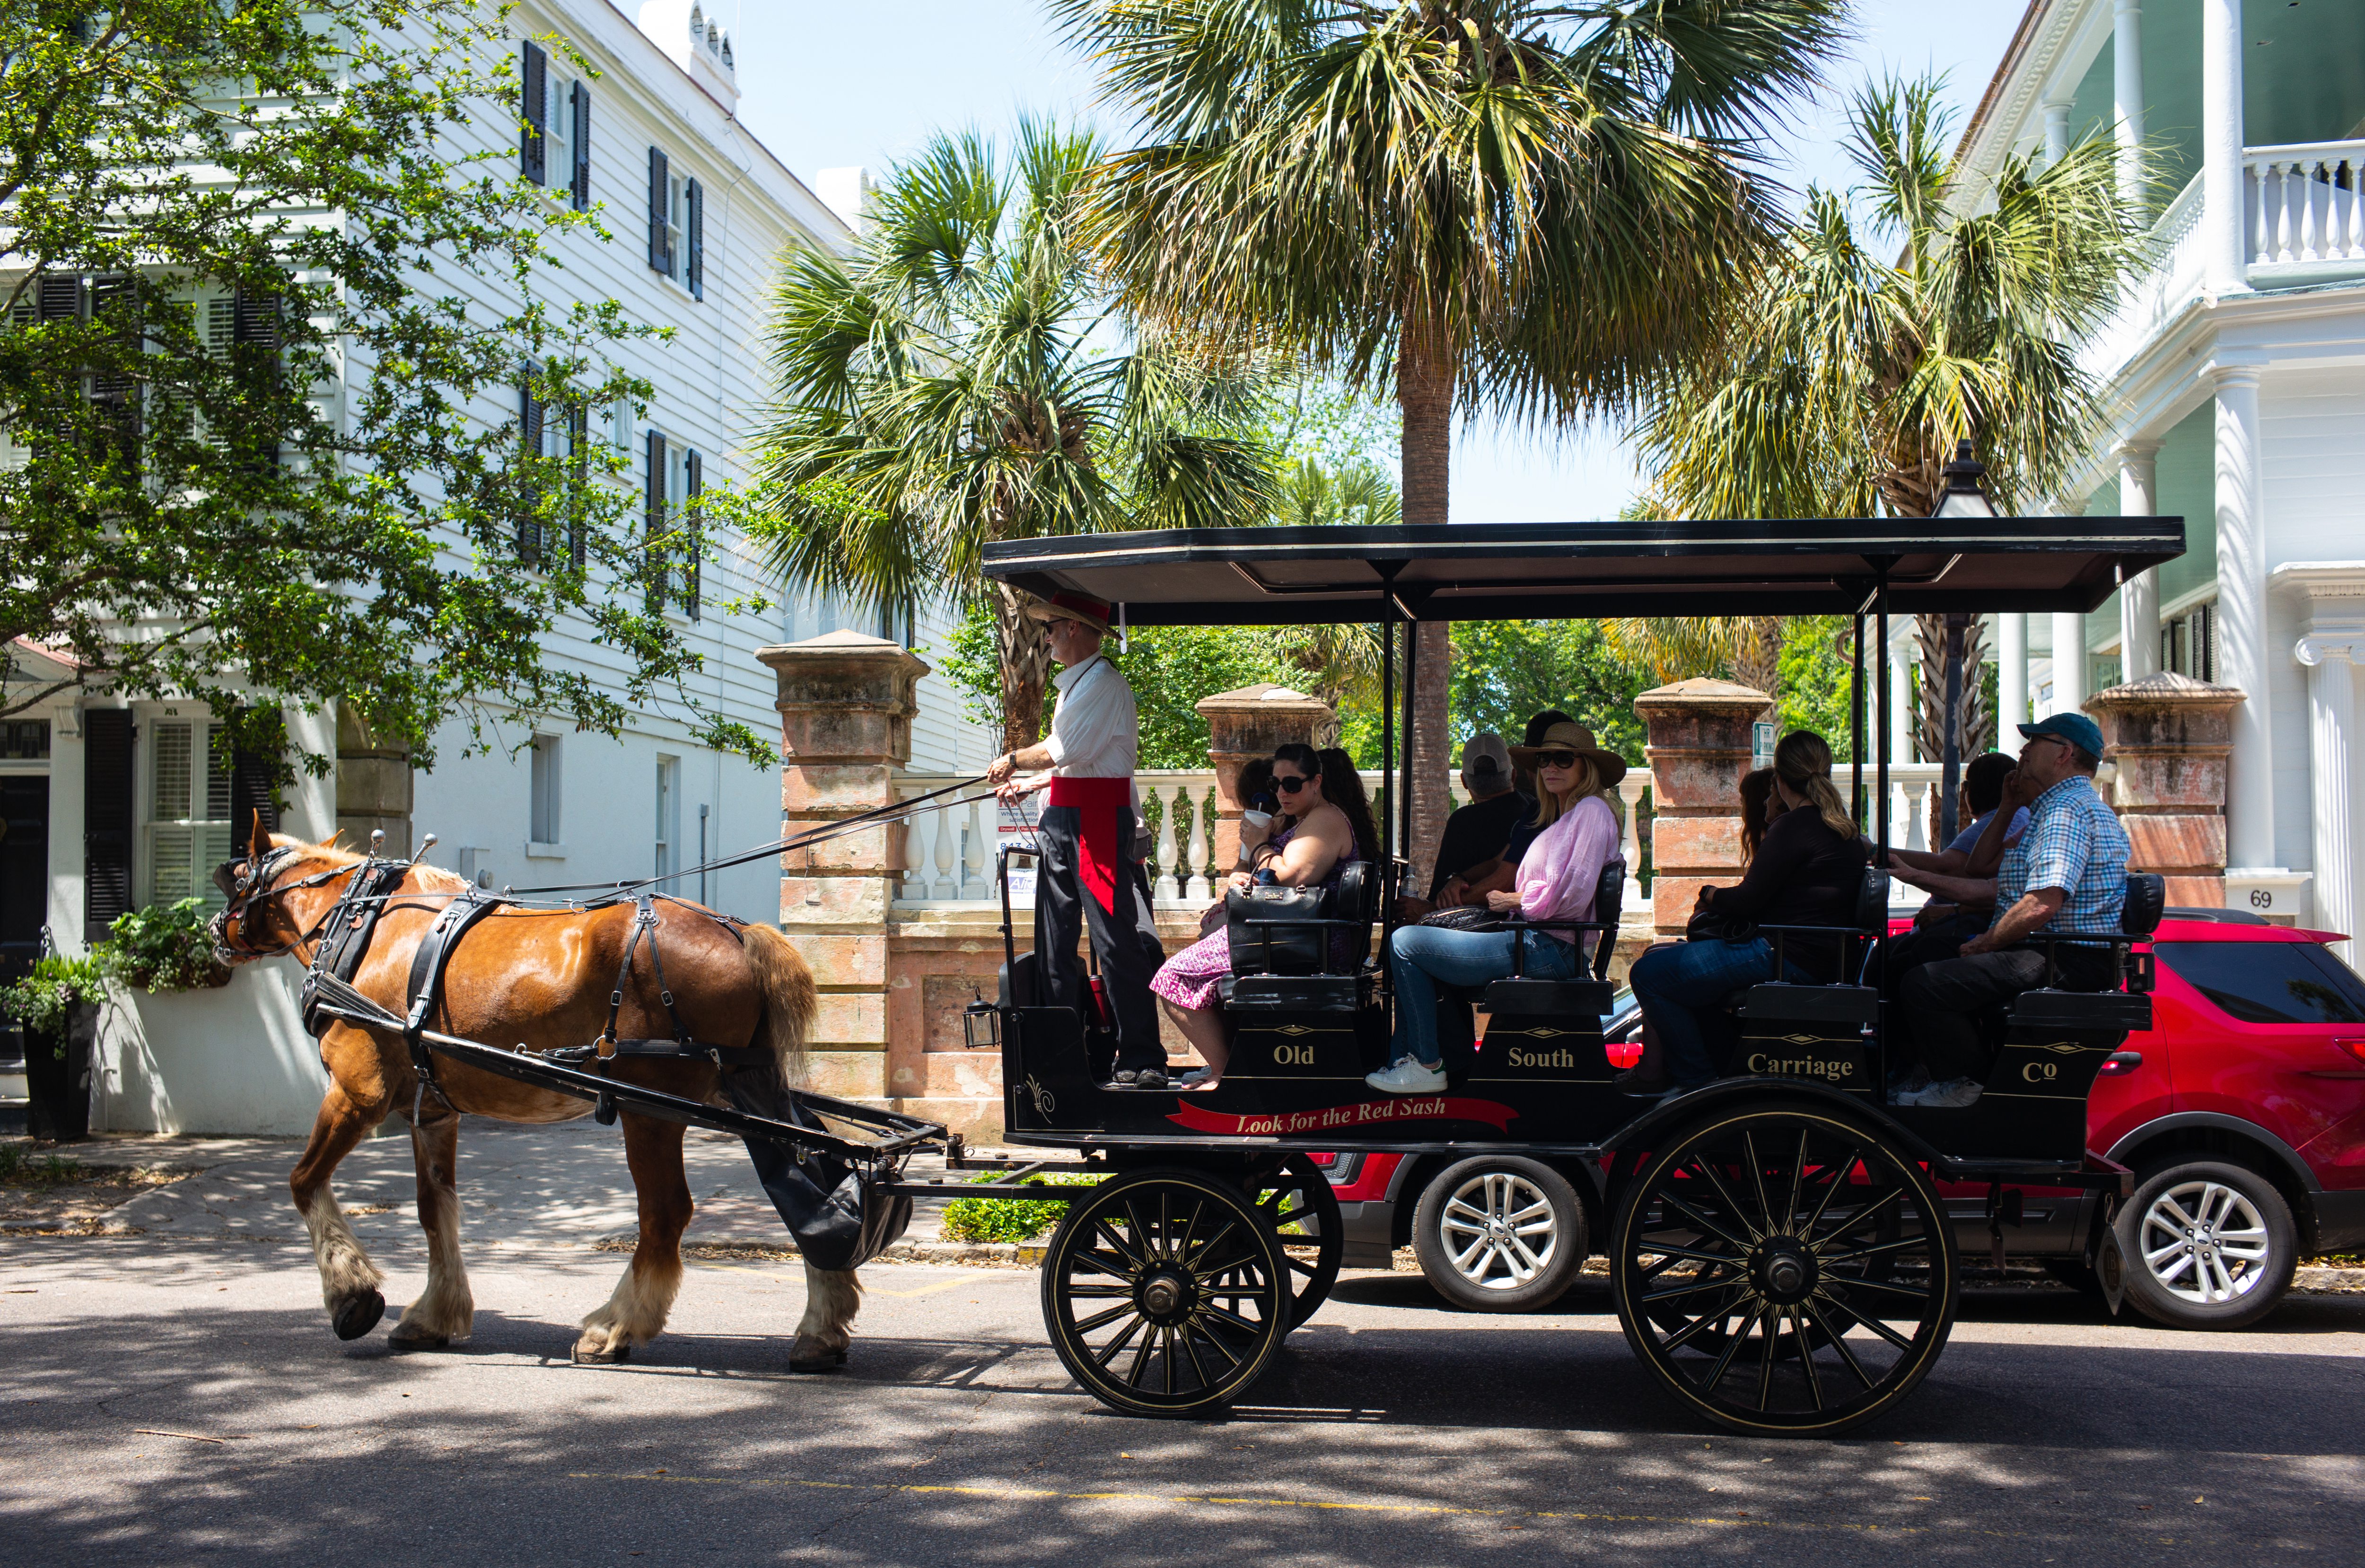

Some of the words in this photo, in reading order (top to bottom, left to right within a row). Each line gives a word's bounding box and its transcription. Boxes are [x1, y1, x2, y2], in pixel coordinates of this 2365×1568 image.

[1764, 728, 1770, 738] HR
[2251, 890, 2271, 908] 69
[1274, 1045, 1314, 1064] Old
[1508, 1047, 1574, 1067] South
[1748, 1054, 1853, 1081] Carriage
[1236, 1115, 1283, 1133] Look
[1287, 1113, 1316, 1132] for
[1322, 1107, 1351, 1126] the
[1357, 1099, 1394, 1121] Red
[1399, 1097, 1446, 1116] Sash
